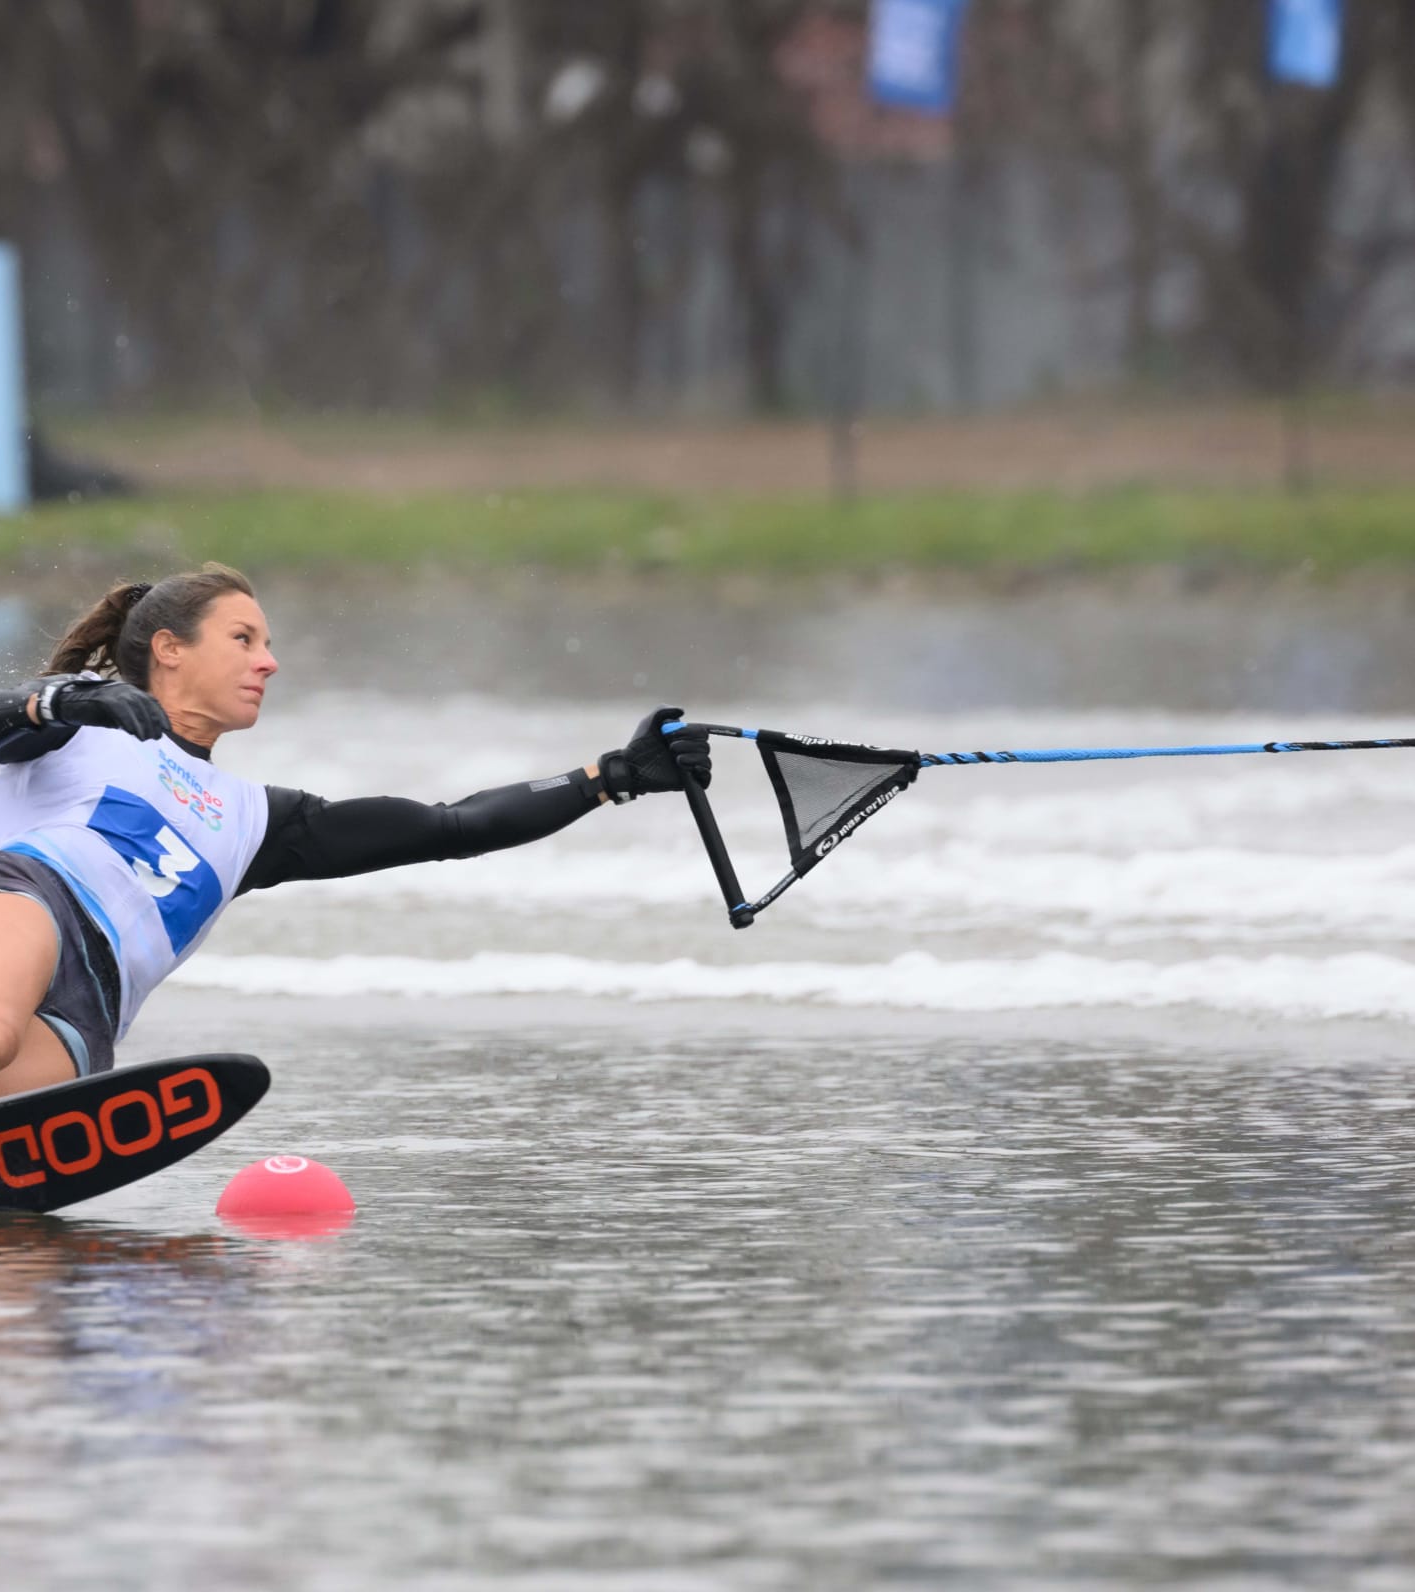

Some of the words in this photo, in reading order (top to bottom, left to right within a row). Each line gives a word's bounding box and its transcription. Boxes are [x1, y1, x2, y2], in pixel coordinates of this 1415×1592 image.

[158, 749, 223, 807] Santiago
[838, 785, 900, 837] masterline
[132, 825, 201, 898] 3
